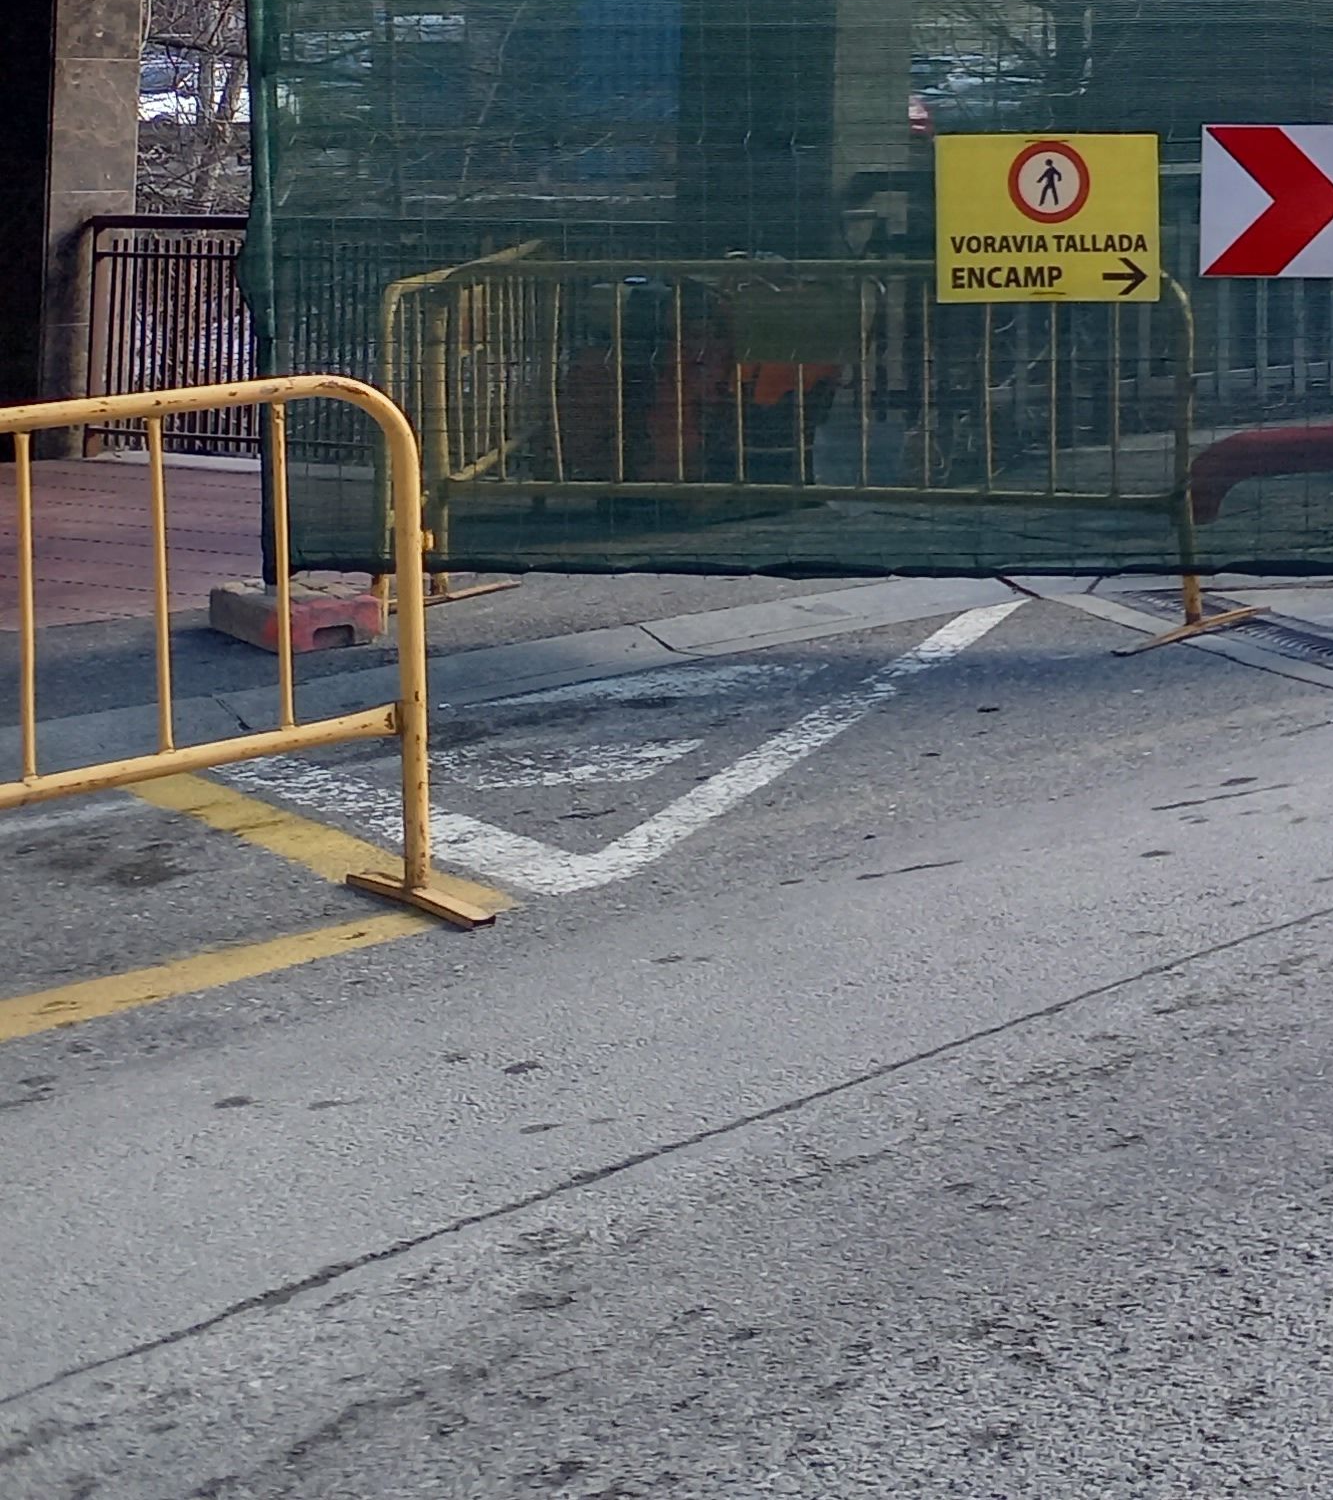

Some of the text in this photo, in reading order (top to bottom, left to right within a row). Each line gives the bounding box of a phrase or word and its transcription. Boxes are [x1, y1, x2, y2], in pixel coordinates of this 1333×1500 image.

[950, 234, 1148, 254] VORAVIA TALLADA
[951, 266, 1063, 289] ENCAMP
